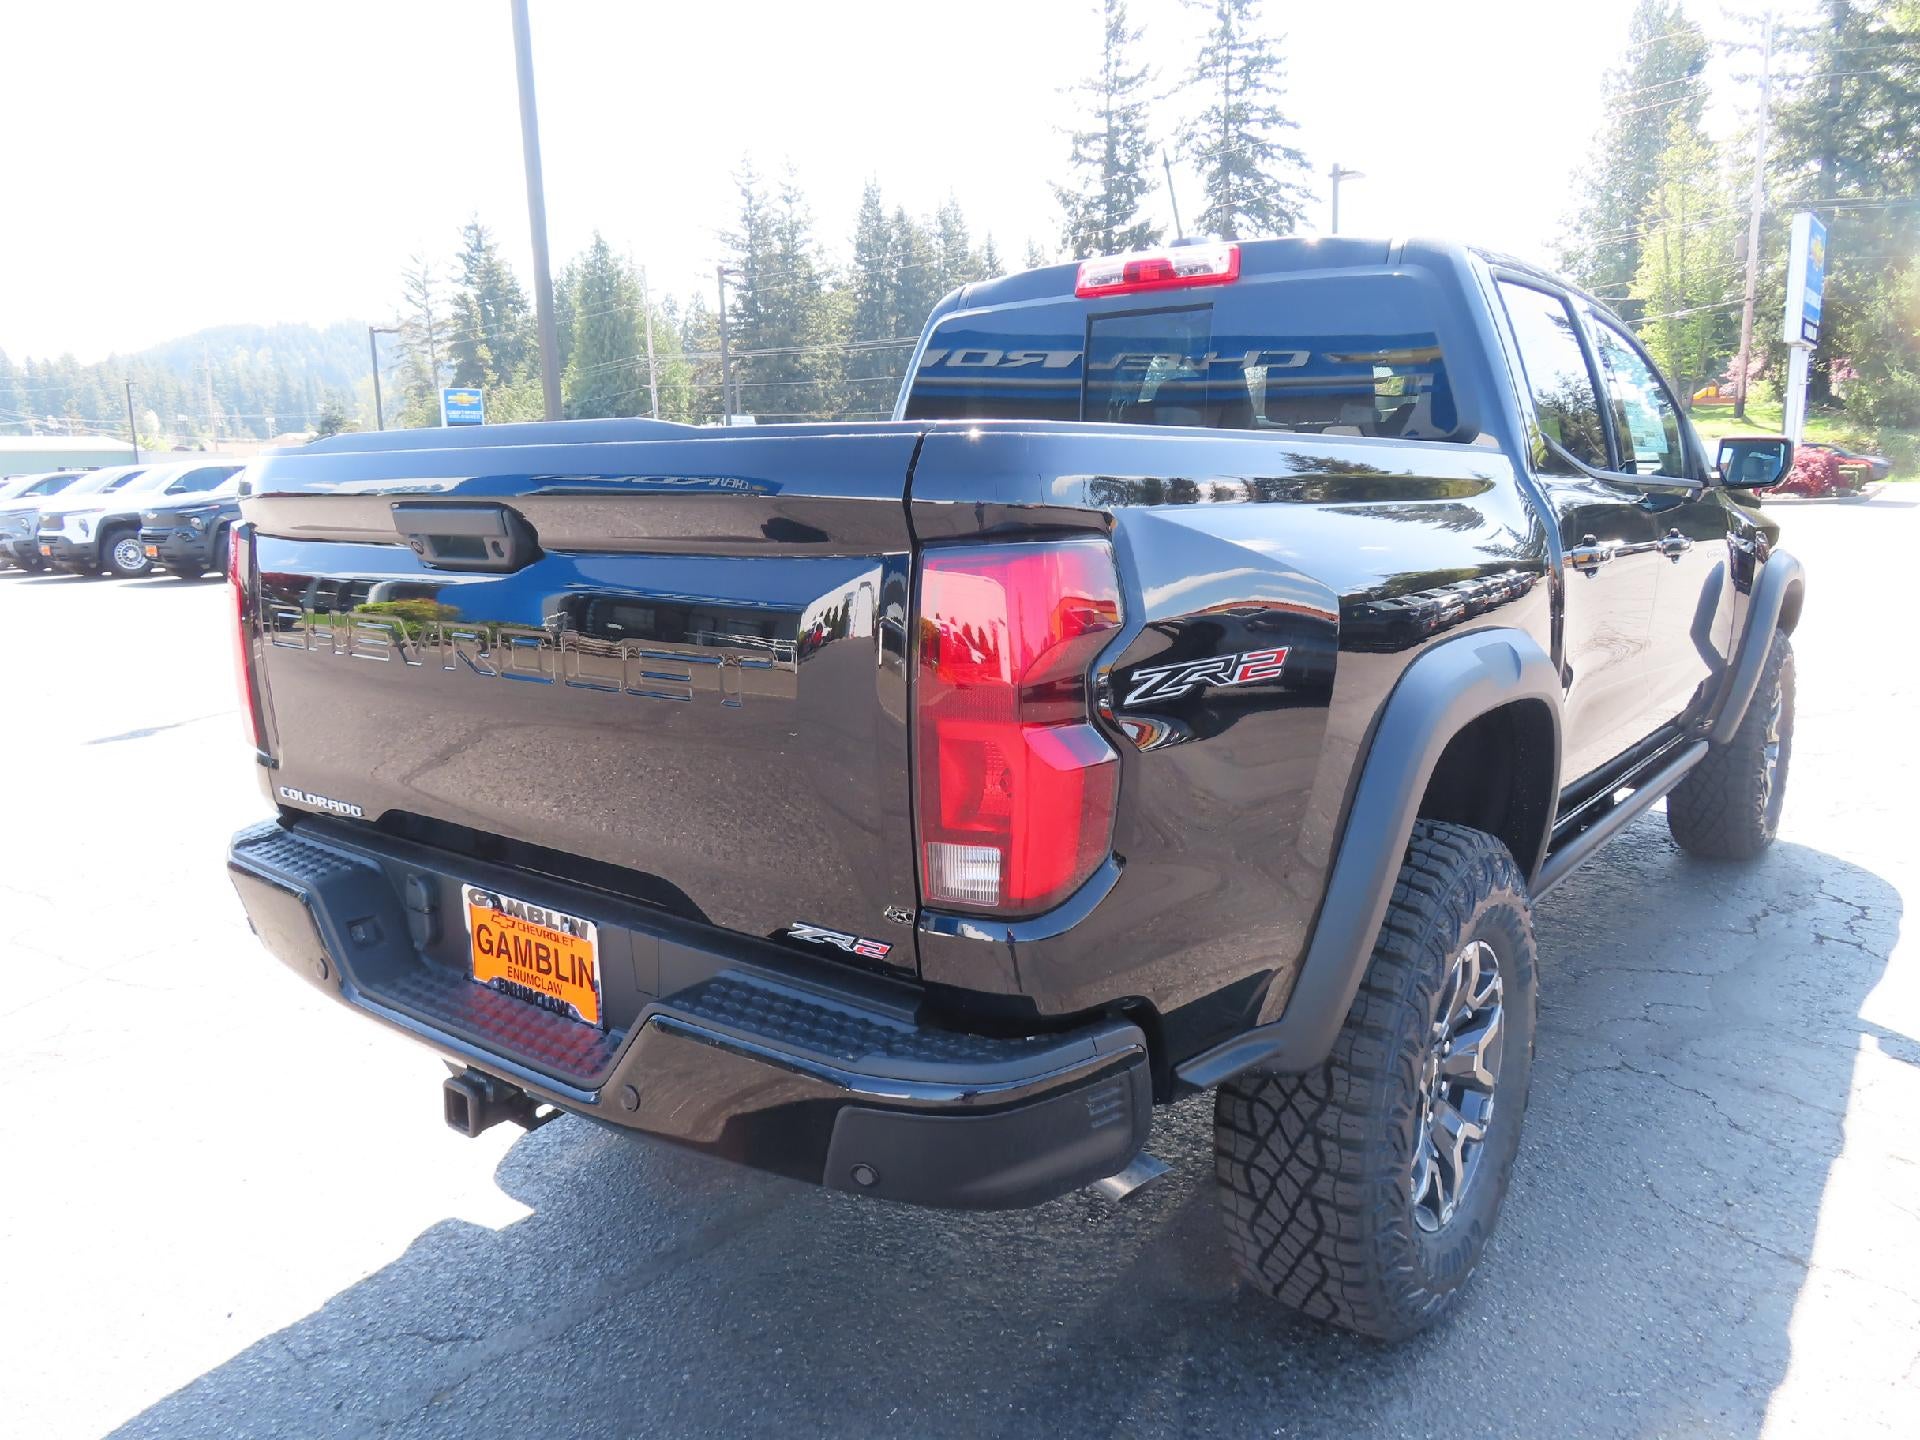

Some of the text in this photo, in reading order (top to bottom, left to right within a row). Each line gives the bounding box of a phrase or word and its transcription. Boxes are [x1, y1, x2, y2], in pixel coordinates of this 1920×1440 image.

[269, 604, 775, 706] CHEVROLET
[1123, 646, 1292, 706] ZR2
[279, 786, 363, 817] COLORADO
[467, 887, 589, 940] GAMBLIN
[517, 921, 575, 948] CHEVROLET
[476, 923, 597, 993] GAMBLIN
[787, 921, 893, 960] ZR2
[507, 965, 563, 996] ENUMCLAW
